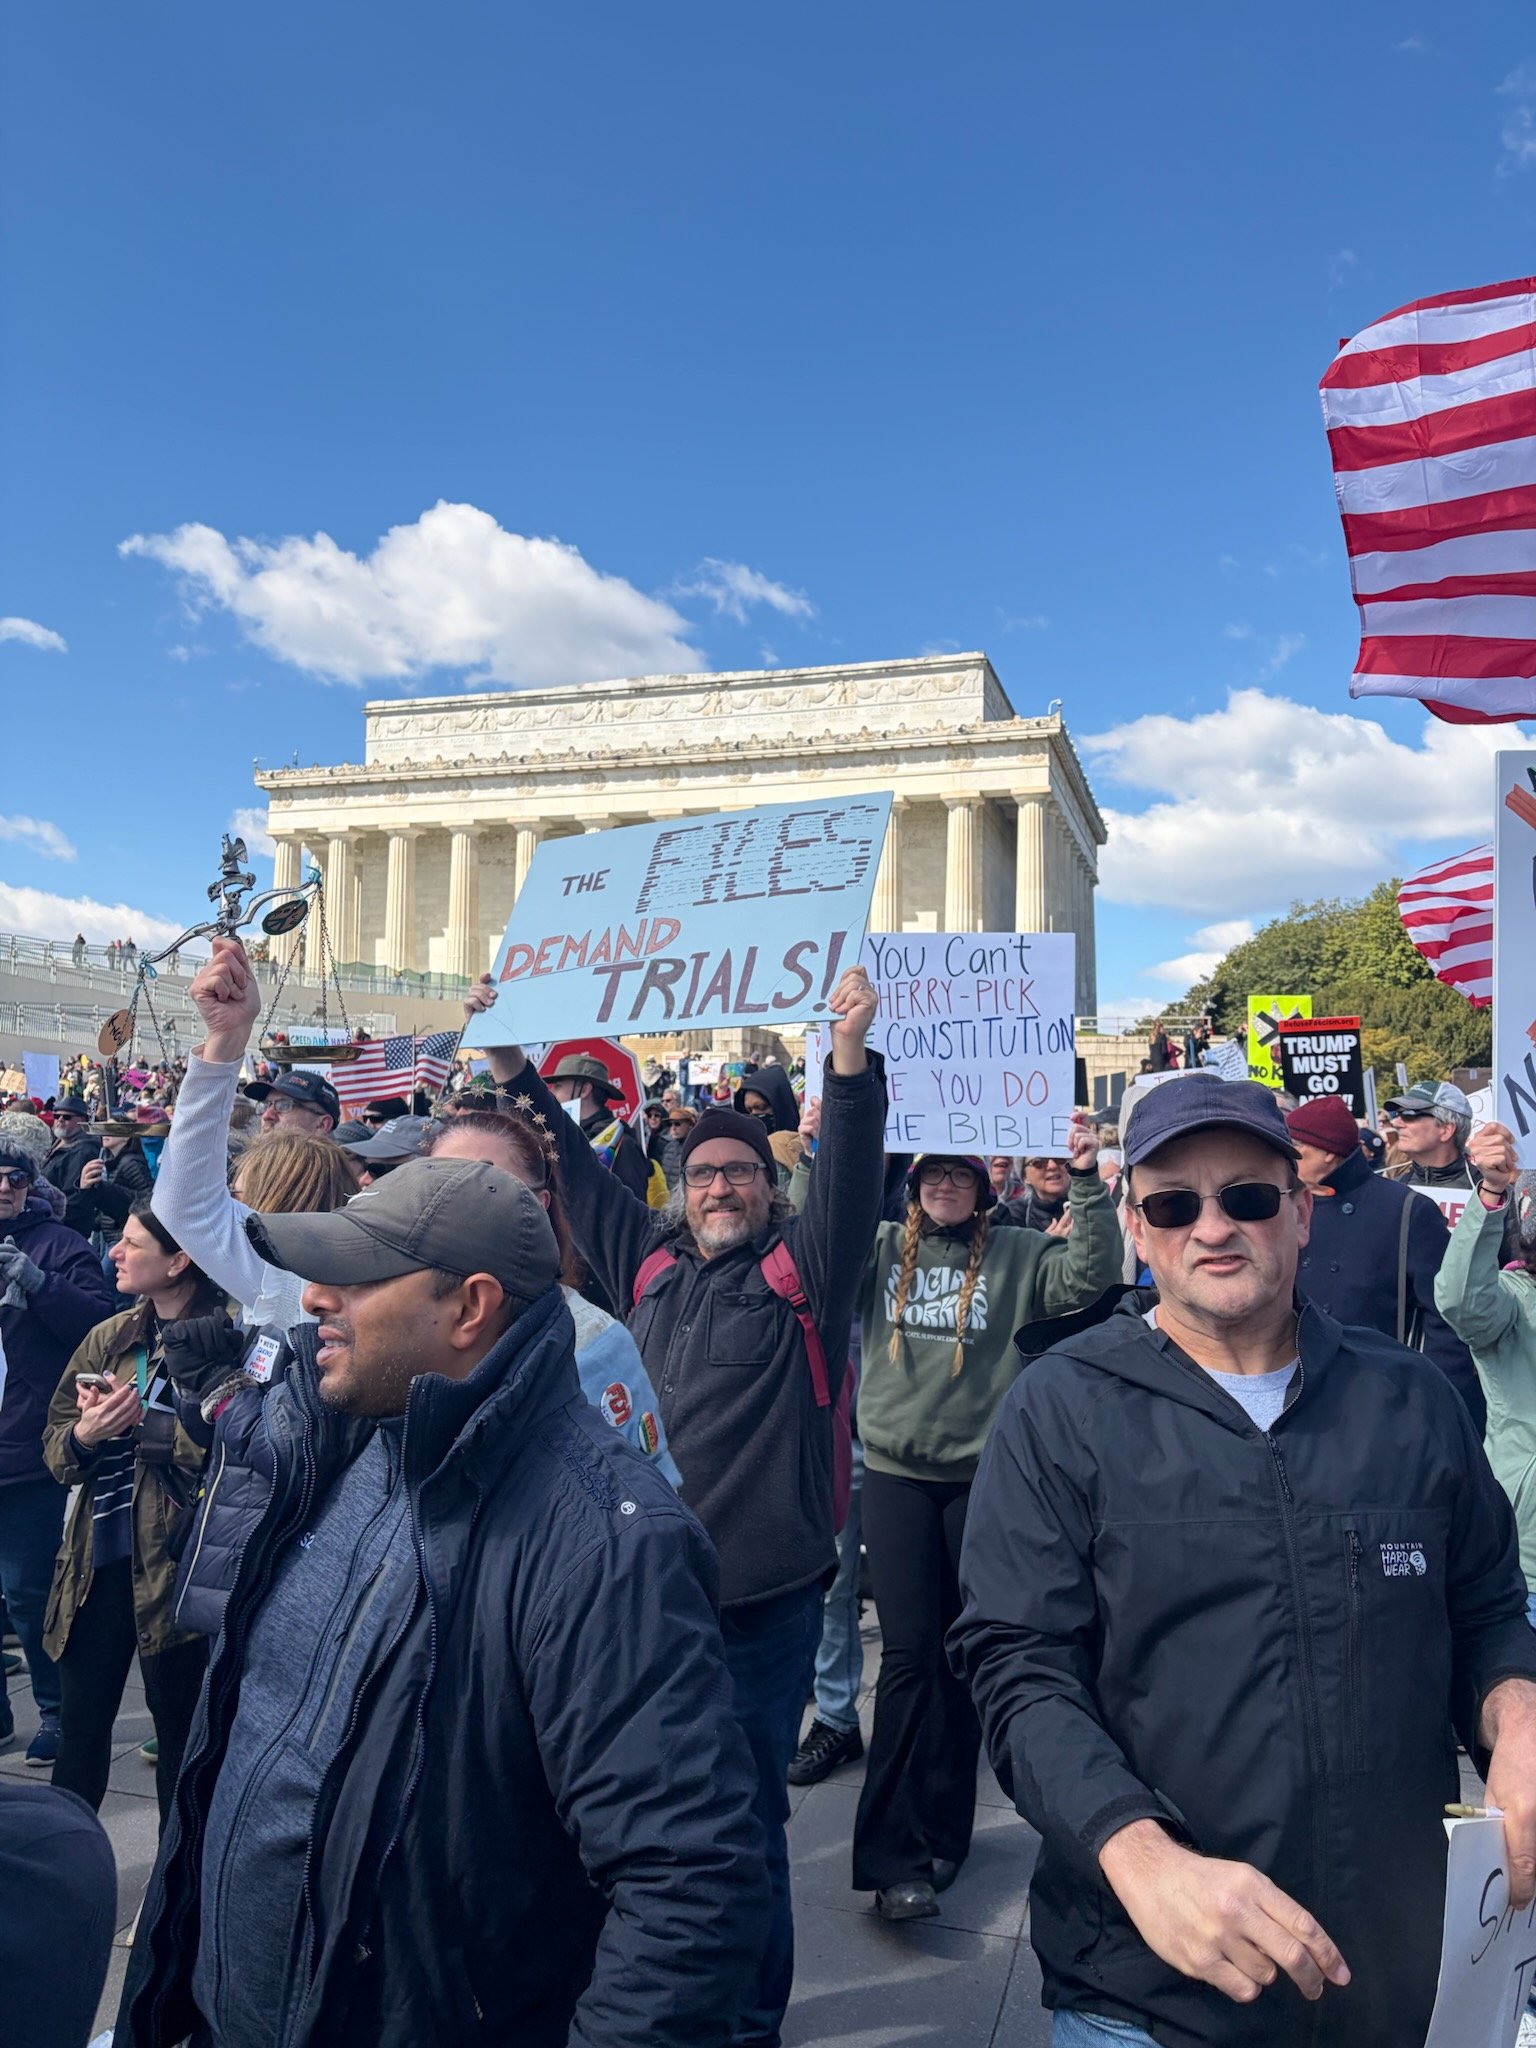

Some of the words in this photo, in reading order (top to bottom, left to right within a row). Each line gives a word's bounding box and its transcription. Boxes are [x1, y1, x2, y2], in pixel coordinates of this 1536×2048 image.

[562, 869, 611, 897] THE
[635, 804, 880, 914] FILES
[499, 916, 682, 983] DEMAND
[945, 935, 1031, 978] Can't
[592, 931, 848, 1023] TRIALS!
[870, 978, 1041, 1020] HERRY-PICK
[290, 1035, 312, 1045] GREED
[886, 1014, 1075, 1062] CONSTITUTION
[1283, 1034, 1358, 1055] TRUMP
[1248, 1064, 1268, 1078] NO
[1292, 1055, 1351, 1074] MUST
[931, 1069, 982, 1108] YOU
[1003, 1070, 1049, 1107] DO
[1307, 1074, 1339, 1093] GO
[884, 1113, 925, 1142] HE
[948, 1113, 1071, 1149] BIBLE
[1380, 1542, 1423, 1551] MOUNTAIN
[1381, 1551, 1409, 1564] HARD
[1383, 1564, 1412, 1577] WEAR
